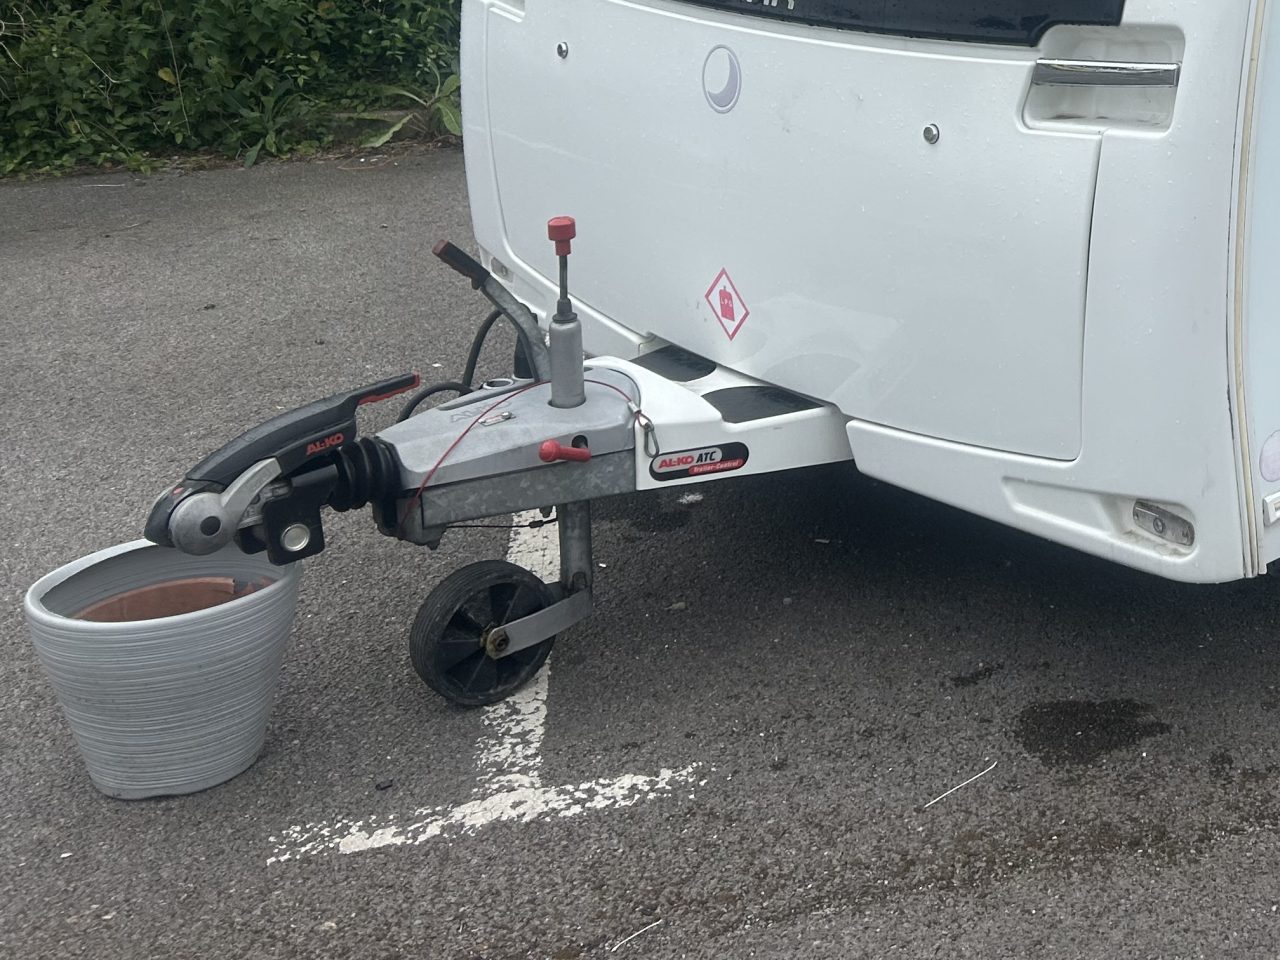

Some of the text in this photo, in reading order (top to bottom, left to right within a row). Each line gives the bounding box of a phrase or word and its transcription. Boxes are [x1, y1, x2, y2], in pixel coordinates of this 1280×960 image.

[306, 432, 344, 456] AL-KO
[658, 451, 716, 469] AL-KO ATC
